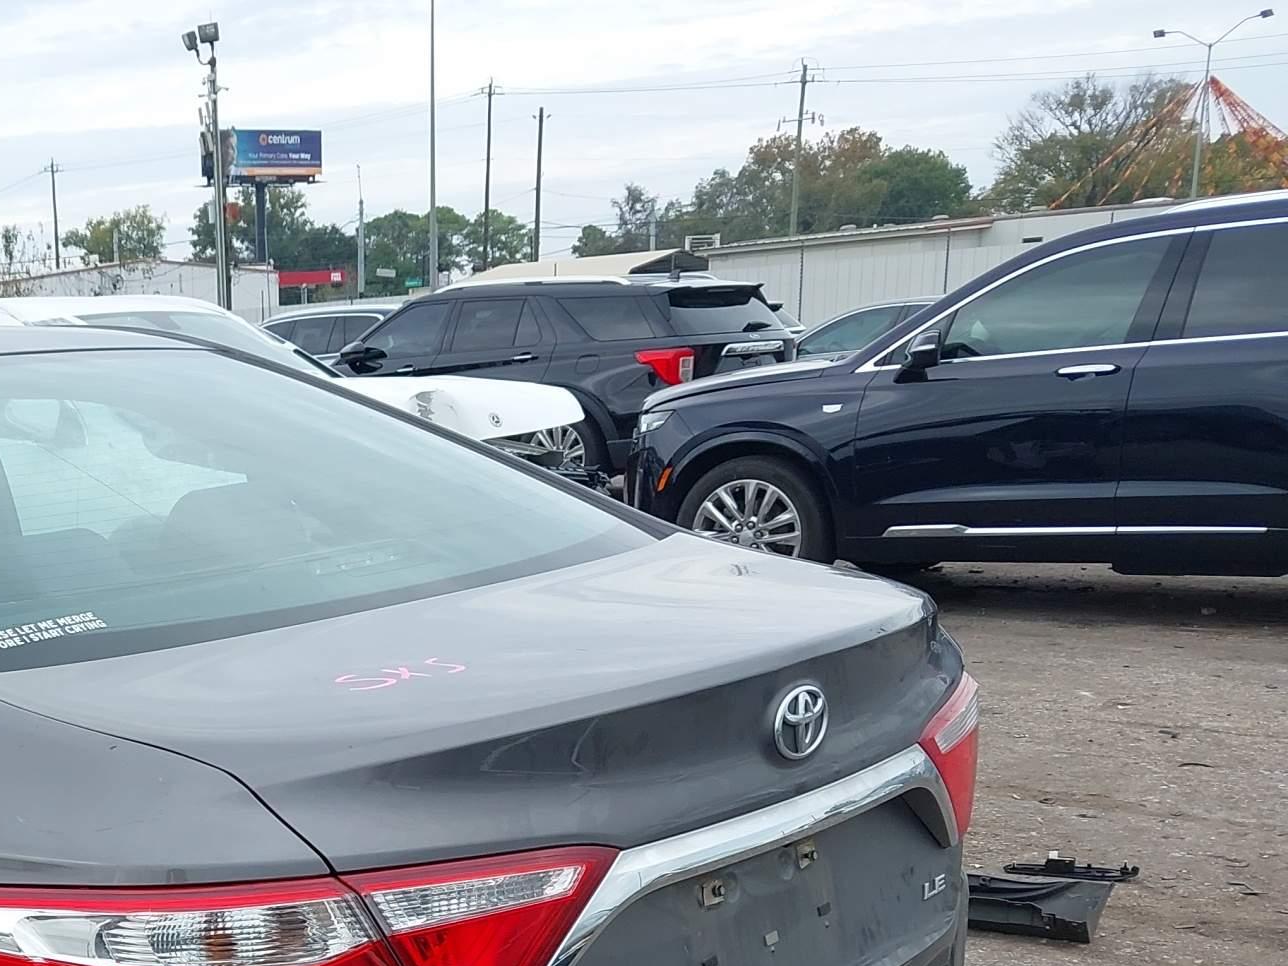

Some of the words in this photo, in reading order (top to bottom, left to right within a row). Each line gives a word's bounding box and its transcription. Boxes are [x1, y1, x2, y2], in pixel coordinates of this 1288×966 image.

[268, 133, 301, 144] centrum
[15, 623, 39, 635] LET
[37, 619, 59, 631] ME
[56, 611, 99, 627] MERGE
[30, 627, 65, 643] START
[64, 619, 108, 635] CRYING
[922, 873, 947, 901] LE
